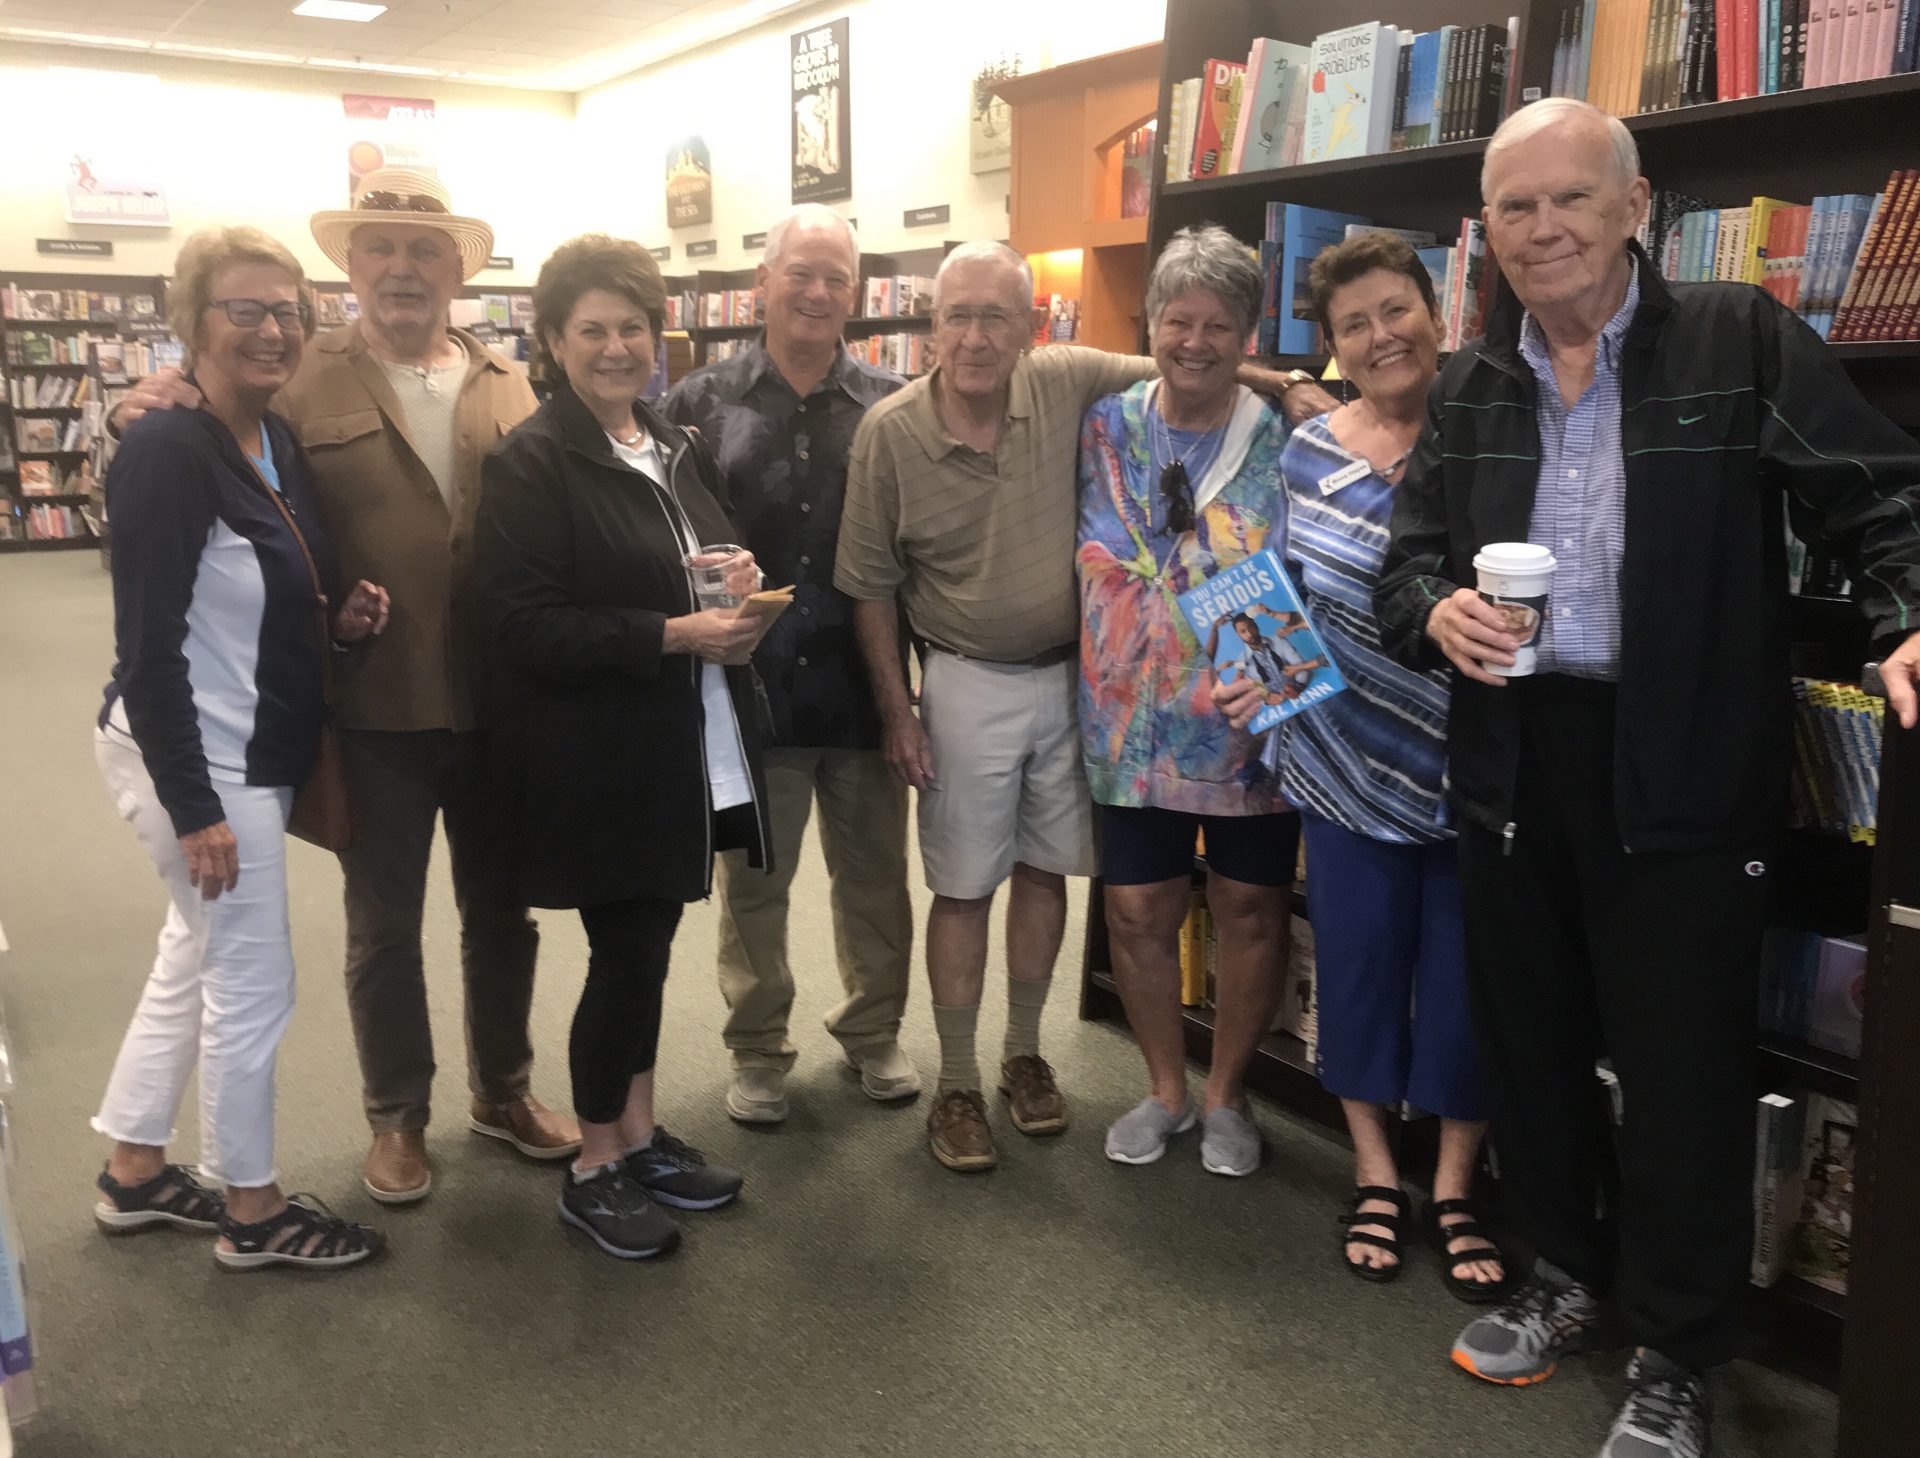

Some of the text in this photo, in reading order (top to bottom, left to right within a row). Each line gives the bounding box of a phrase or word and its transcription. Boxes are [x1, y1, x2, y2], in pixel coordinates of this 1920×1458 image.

[798, 27, 833, 54] A TREE
[1319, 32, 1372, 56] SOLUTIONS
[793, 43, 839, 72] GROWS IN
[1317, 52, 1371, 75] PROBLEMS
[793, 62, 840, 91] BROOKLYN
[1189, 588, 1210, 604] YOU
[1243, 561, 1259, 575] BE
[1191, 568, 1275, 628] SERIOUS
[1255, 682, 1334, 728] KAL PENN
